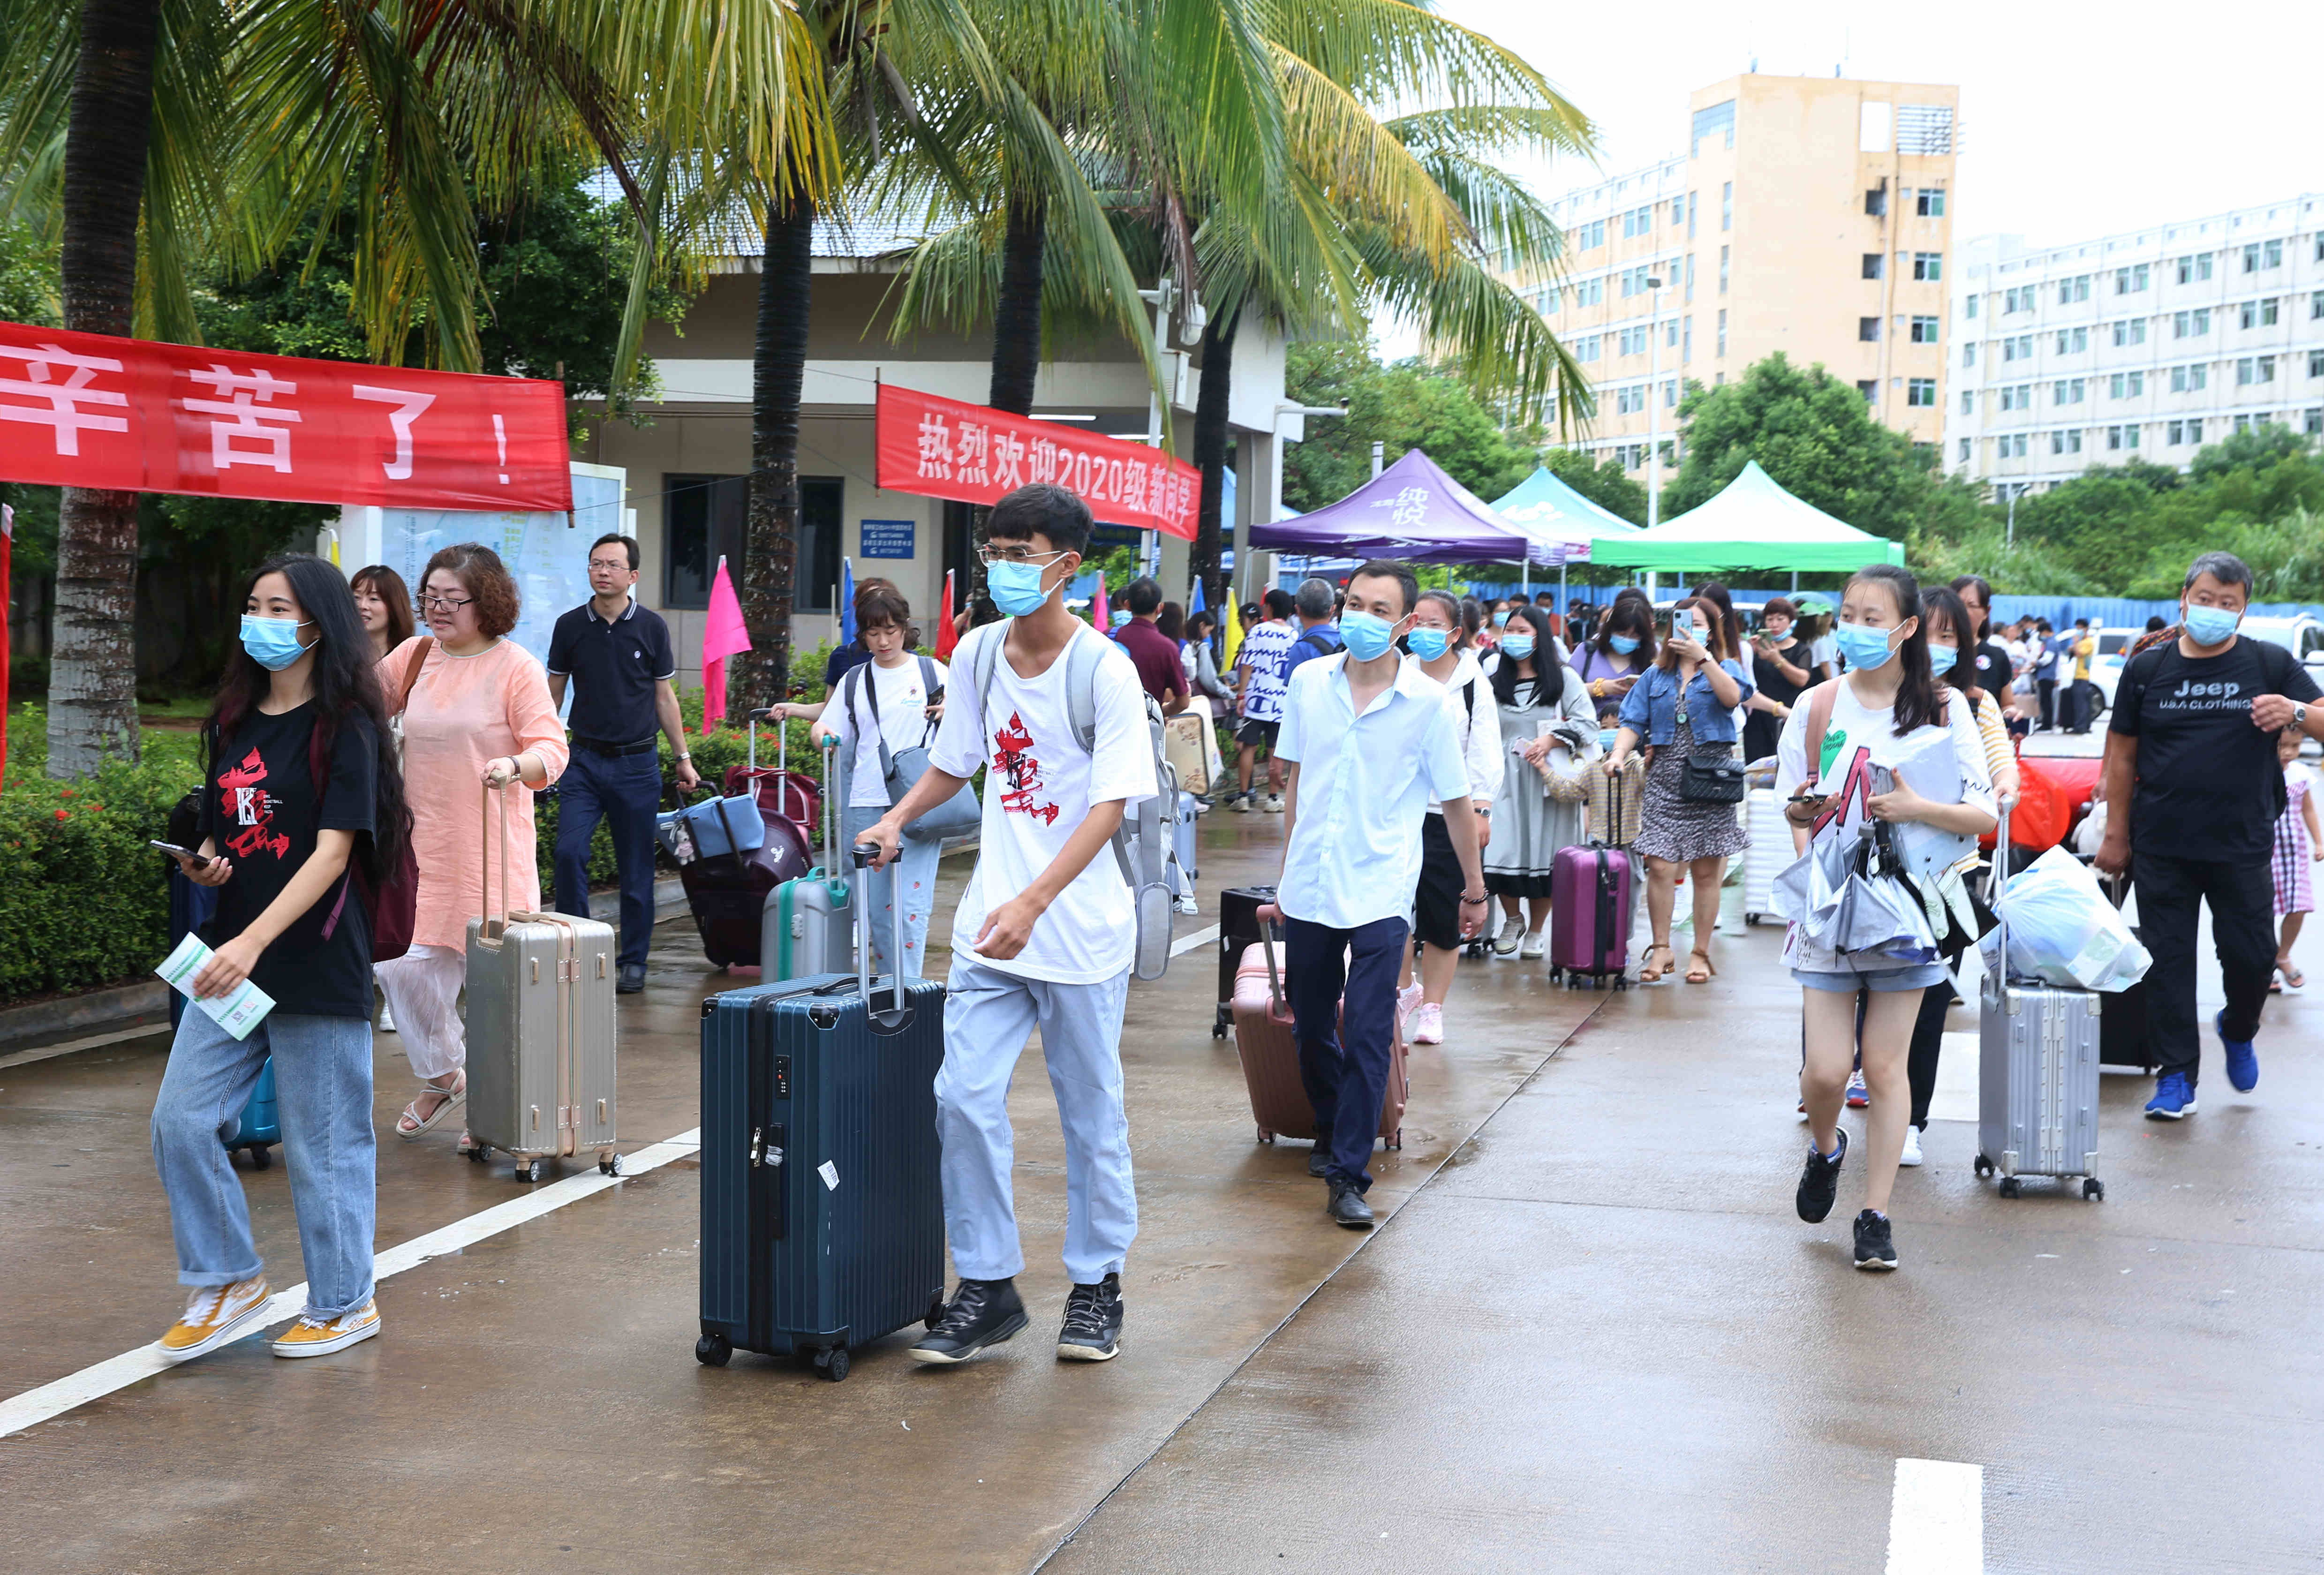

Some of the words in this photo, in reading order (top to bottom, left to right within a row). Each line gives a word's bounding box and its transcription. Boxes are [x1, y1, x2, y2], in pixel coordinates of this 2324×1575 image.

[917, 413, 1191, 526] 热烈欢迎2020级新同学
[2173, 679, 2240, 699] Jeep
[2188, 697, 2252, 710] CLOTHING
